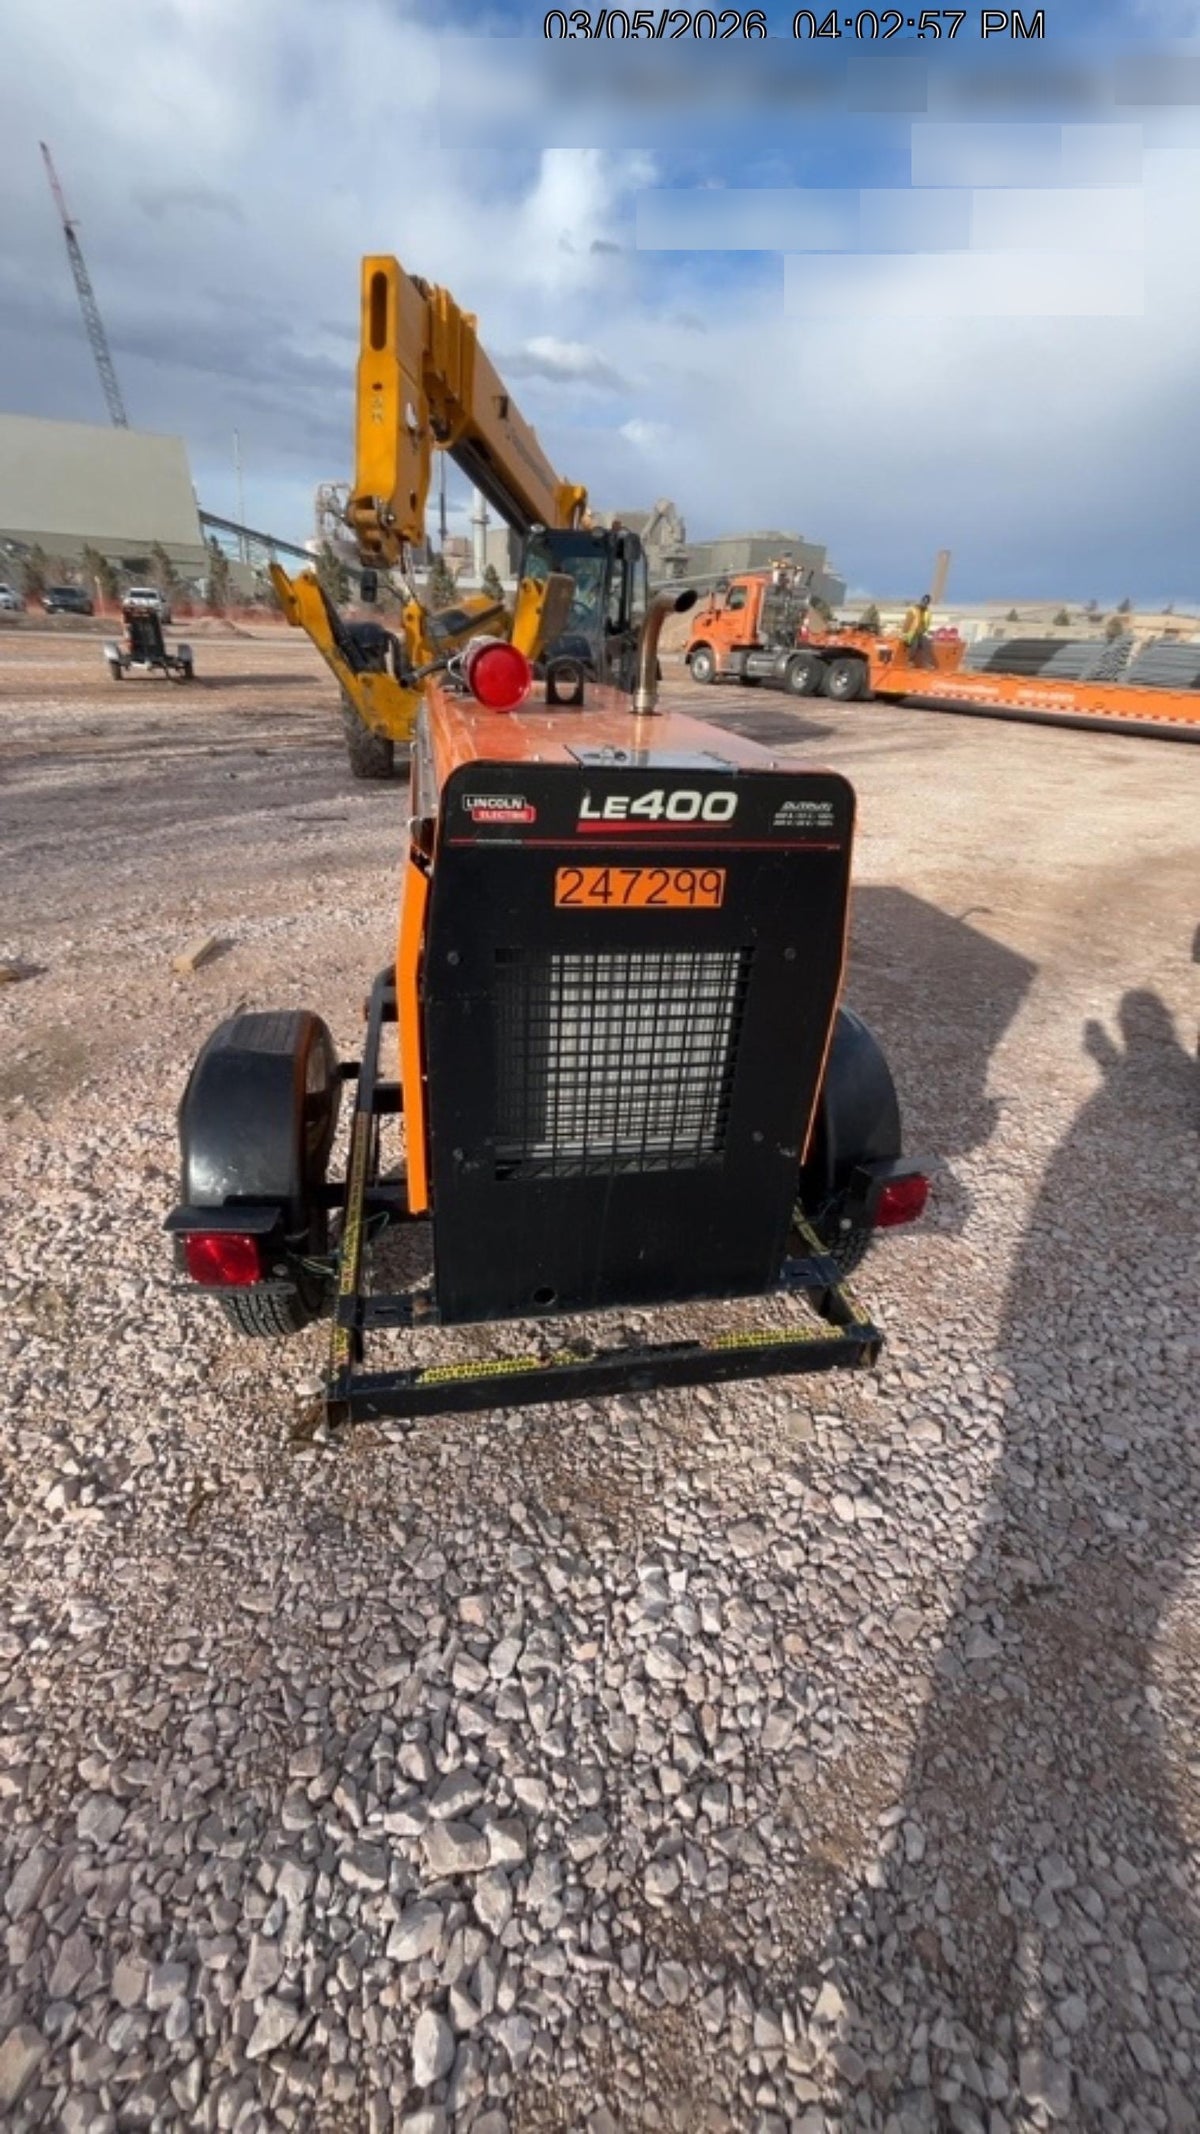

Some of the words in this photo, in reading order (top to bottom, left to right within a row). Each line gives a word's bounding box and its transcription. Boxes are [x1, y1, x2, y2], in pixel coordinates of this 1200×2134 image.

[466, 797, 523, 809] LINCOLN
[579, 789, 738, 821] LE400
[560, 869, 723, 904] 247299
